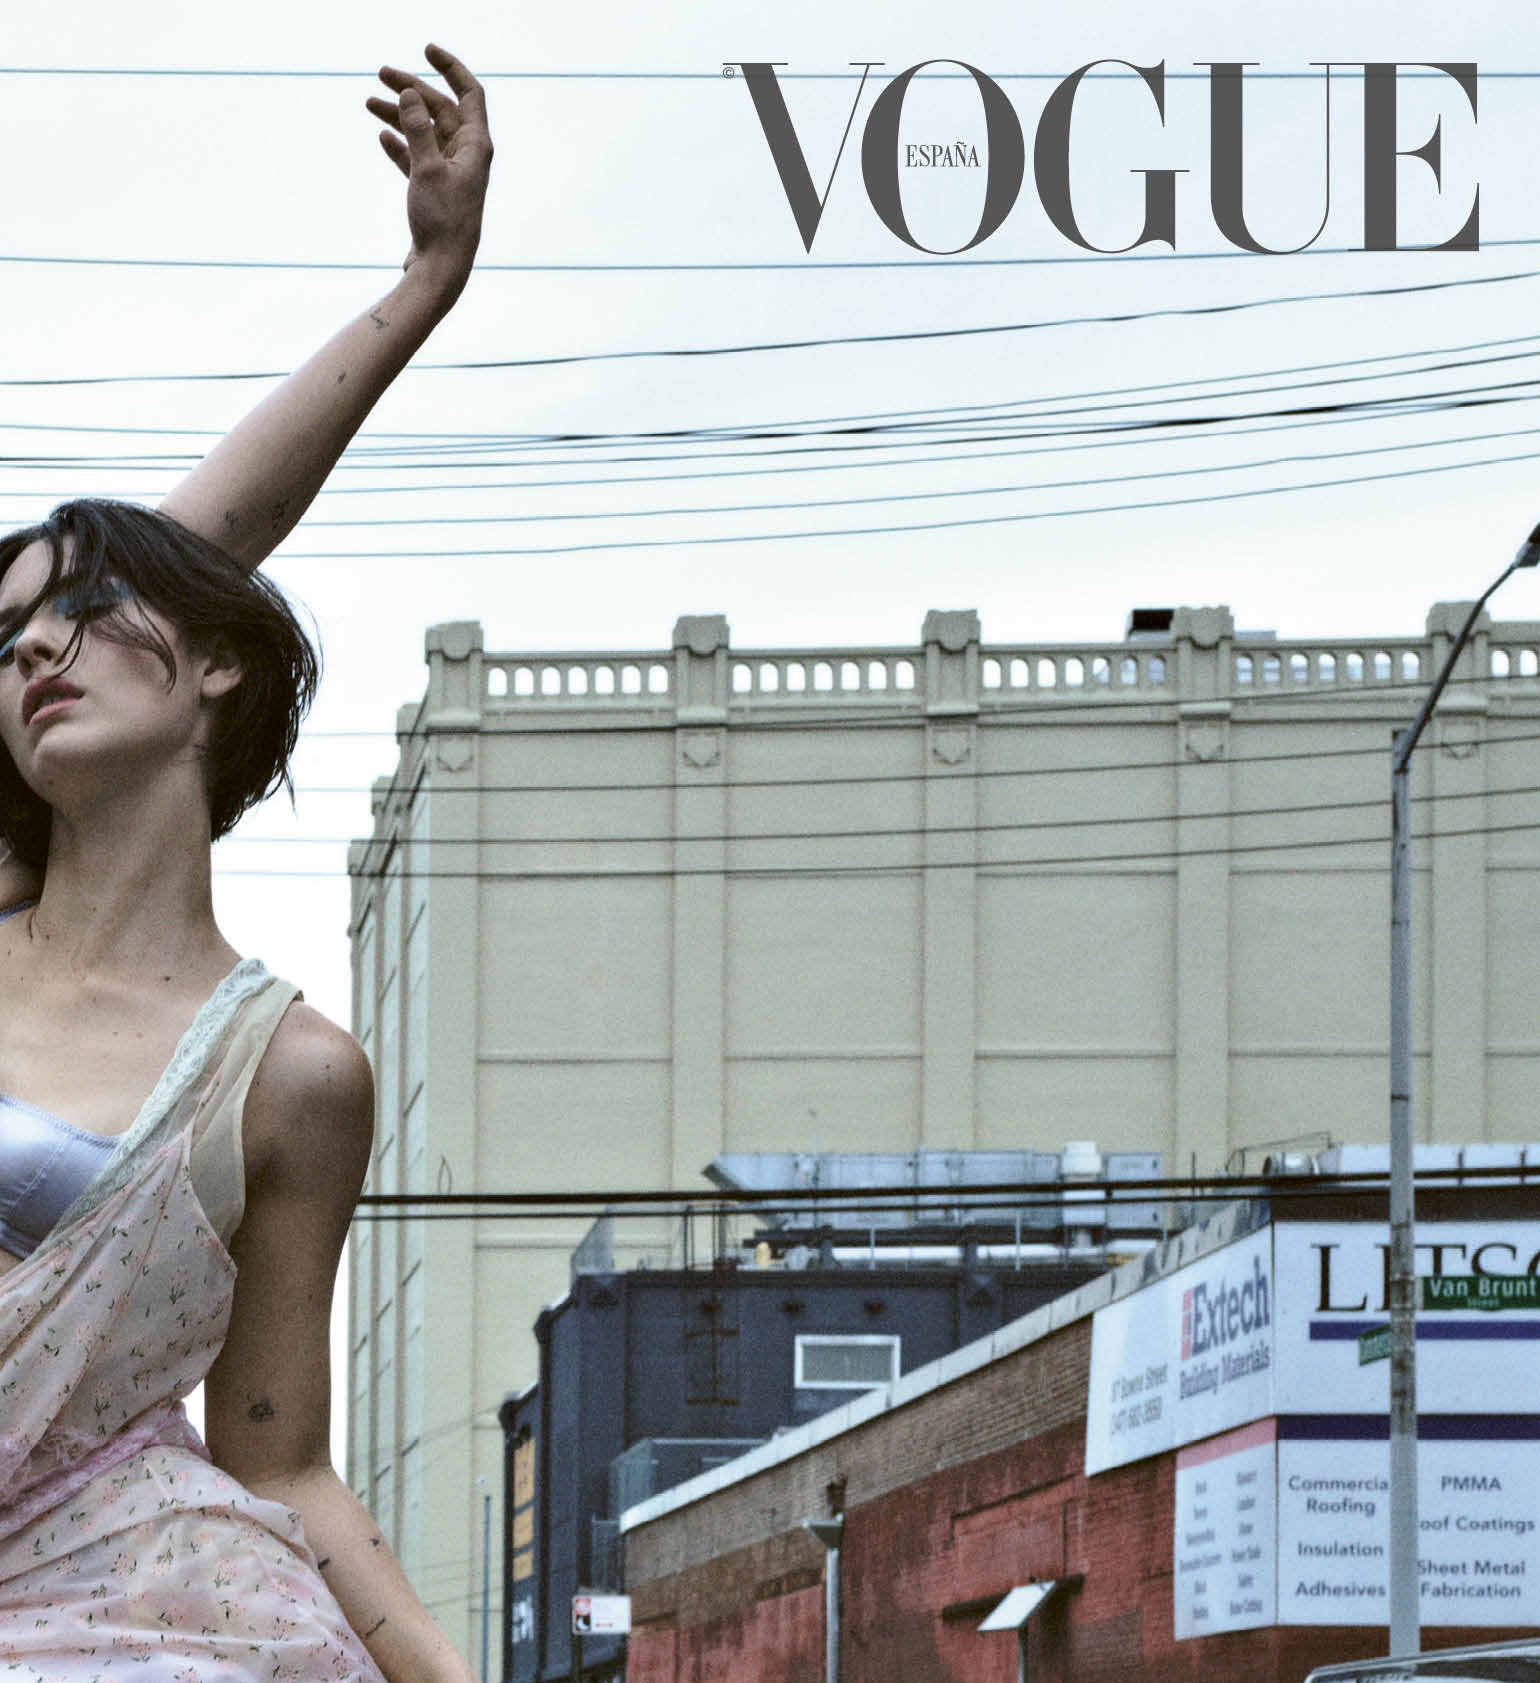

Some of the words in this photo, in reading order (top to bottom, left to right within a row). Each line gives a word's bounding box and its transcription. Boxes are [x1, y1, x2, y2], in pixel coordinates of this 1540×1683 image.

[1429, 1278, 1468, 1297] Van
[1478, 1277, 1537, 1297] Brunt
[1193, 1255, 1270, 1356] Extech
[1180, 1361, 1219, 1400] Building
[1222, 1339, 1270, 1384] Materials
[1288, 1475, 1389, 1492] Commercia
[1441, 1475, 1502, 1492] PMMA
[1306, 1498, 1376, 1517] Roofing
[1418, 1516, 1449, 1531] oof
[1456, 1515, 1536, 1535] Coatings
[1297, 1541, 1384, 1557] Insulation
[1417, 1560, 1467, 1576] Sheet
[1474, 1559, 1526, 1576] Metal
[1295, 1580, 1387, 1598] Adhesives
[1421, 1581, 1521, 1598] Fabrication
